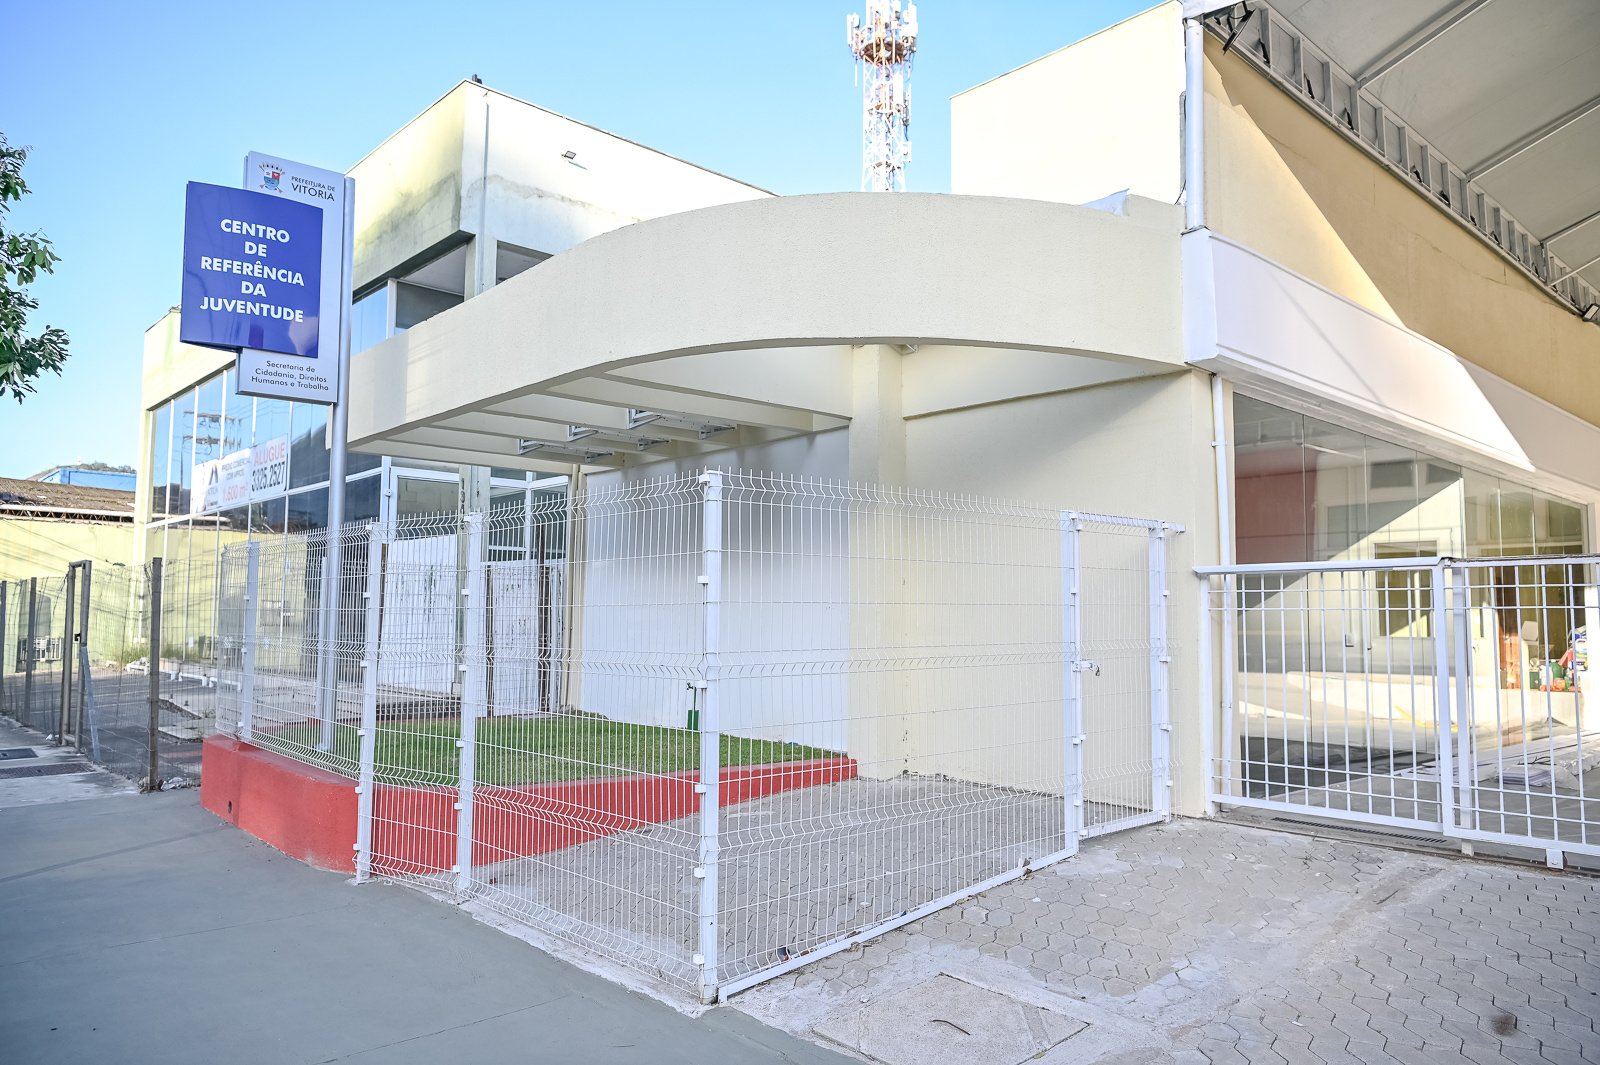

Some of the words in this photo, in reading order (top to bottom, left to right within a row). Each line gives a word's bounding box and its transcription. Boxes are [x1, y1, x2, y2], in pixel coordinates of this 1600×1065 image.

[291, 176, 326, 189] PREFEITURA
[327, 185, 336, 193] DE
[220, 219, 290, 243] CENTRO
[244, 241, 267, 257] DE
[201, 256, 305, 286] REFERÊNCIA
[241, 280, 267, 297] DA
[199, 297, 304, 322] JUVENTUDE
[266, 360, 304, 372] Secretaria
[306, 365, 316, 373] de
[251, 376, 288, 387] Humanos
[297, 381, 329, 391] Trabalho
[255, 368, 297, 380] Cidadania,
[299, 373, 327, 383] Direitos
[254, 441, 286, 466] ALUGUE
[252, 461, 286, 492] 3325.2527
